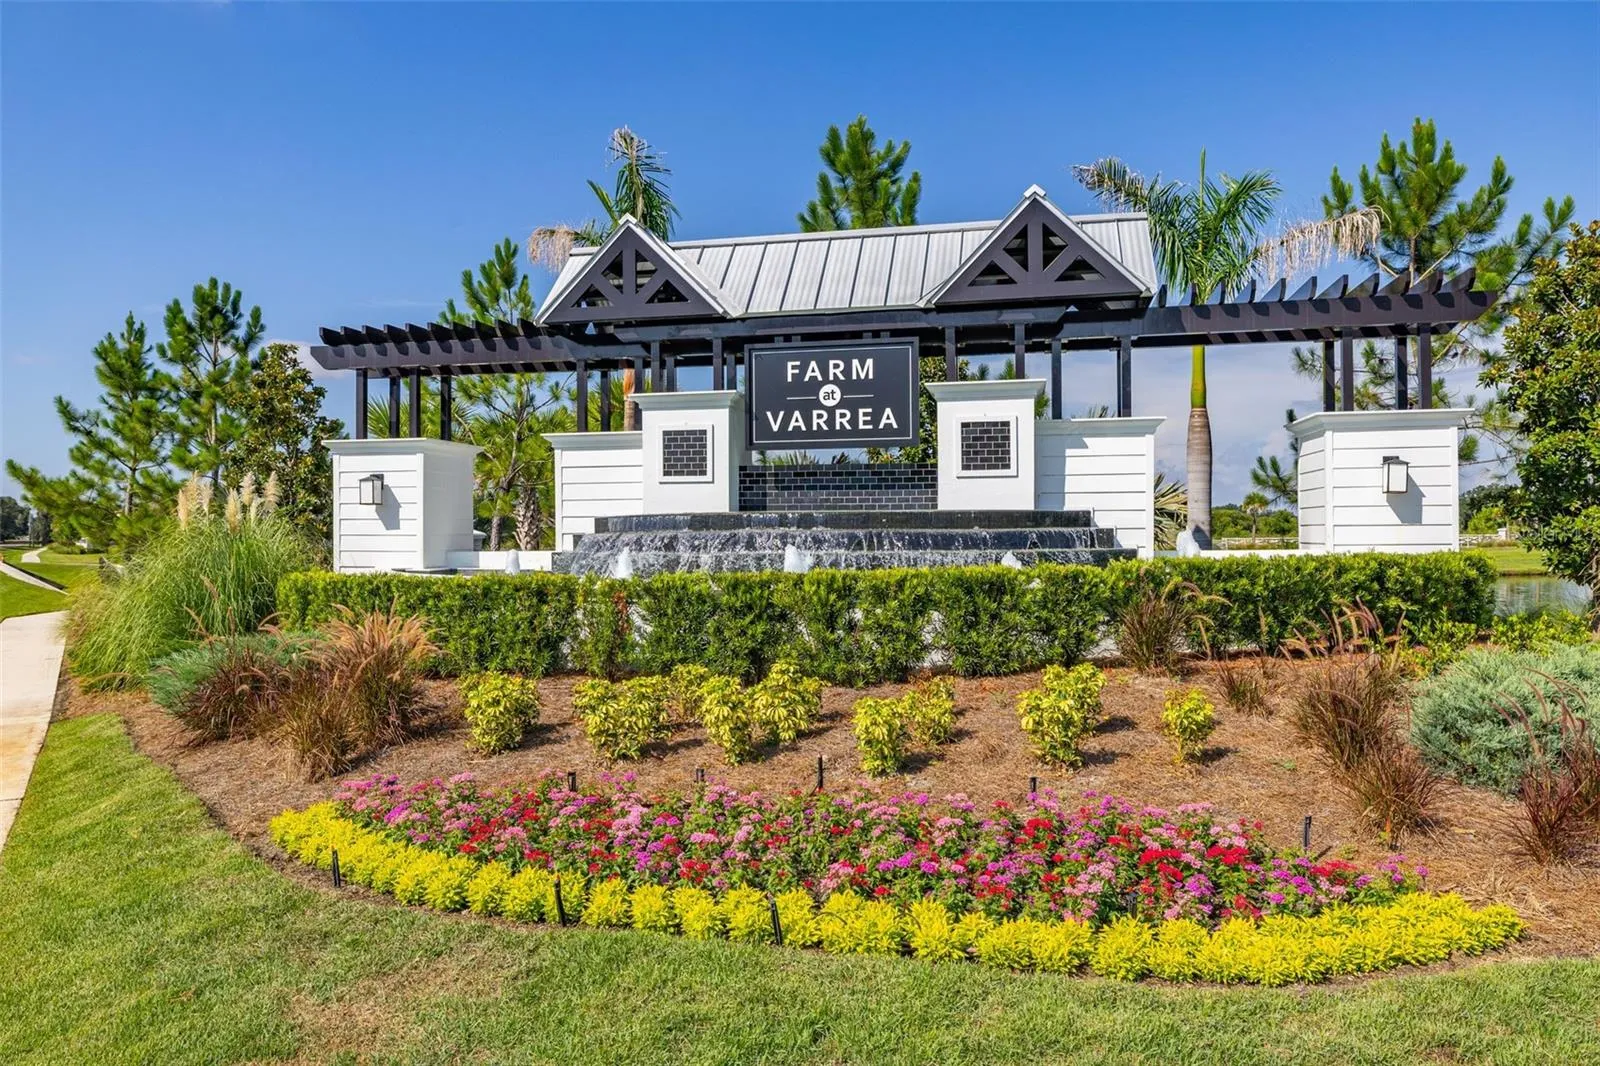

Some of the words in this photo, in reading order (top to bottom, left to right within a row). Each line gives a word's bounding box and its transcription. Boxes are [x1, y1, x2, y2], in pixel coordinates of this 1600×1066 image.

[786, 358, 874, 383] FARM
[822, 388, 837, 401] at
[765, 407, 899, 432] VARREA
